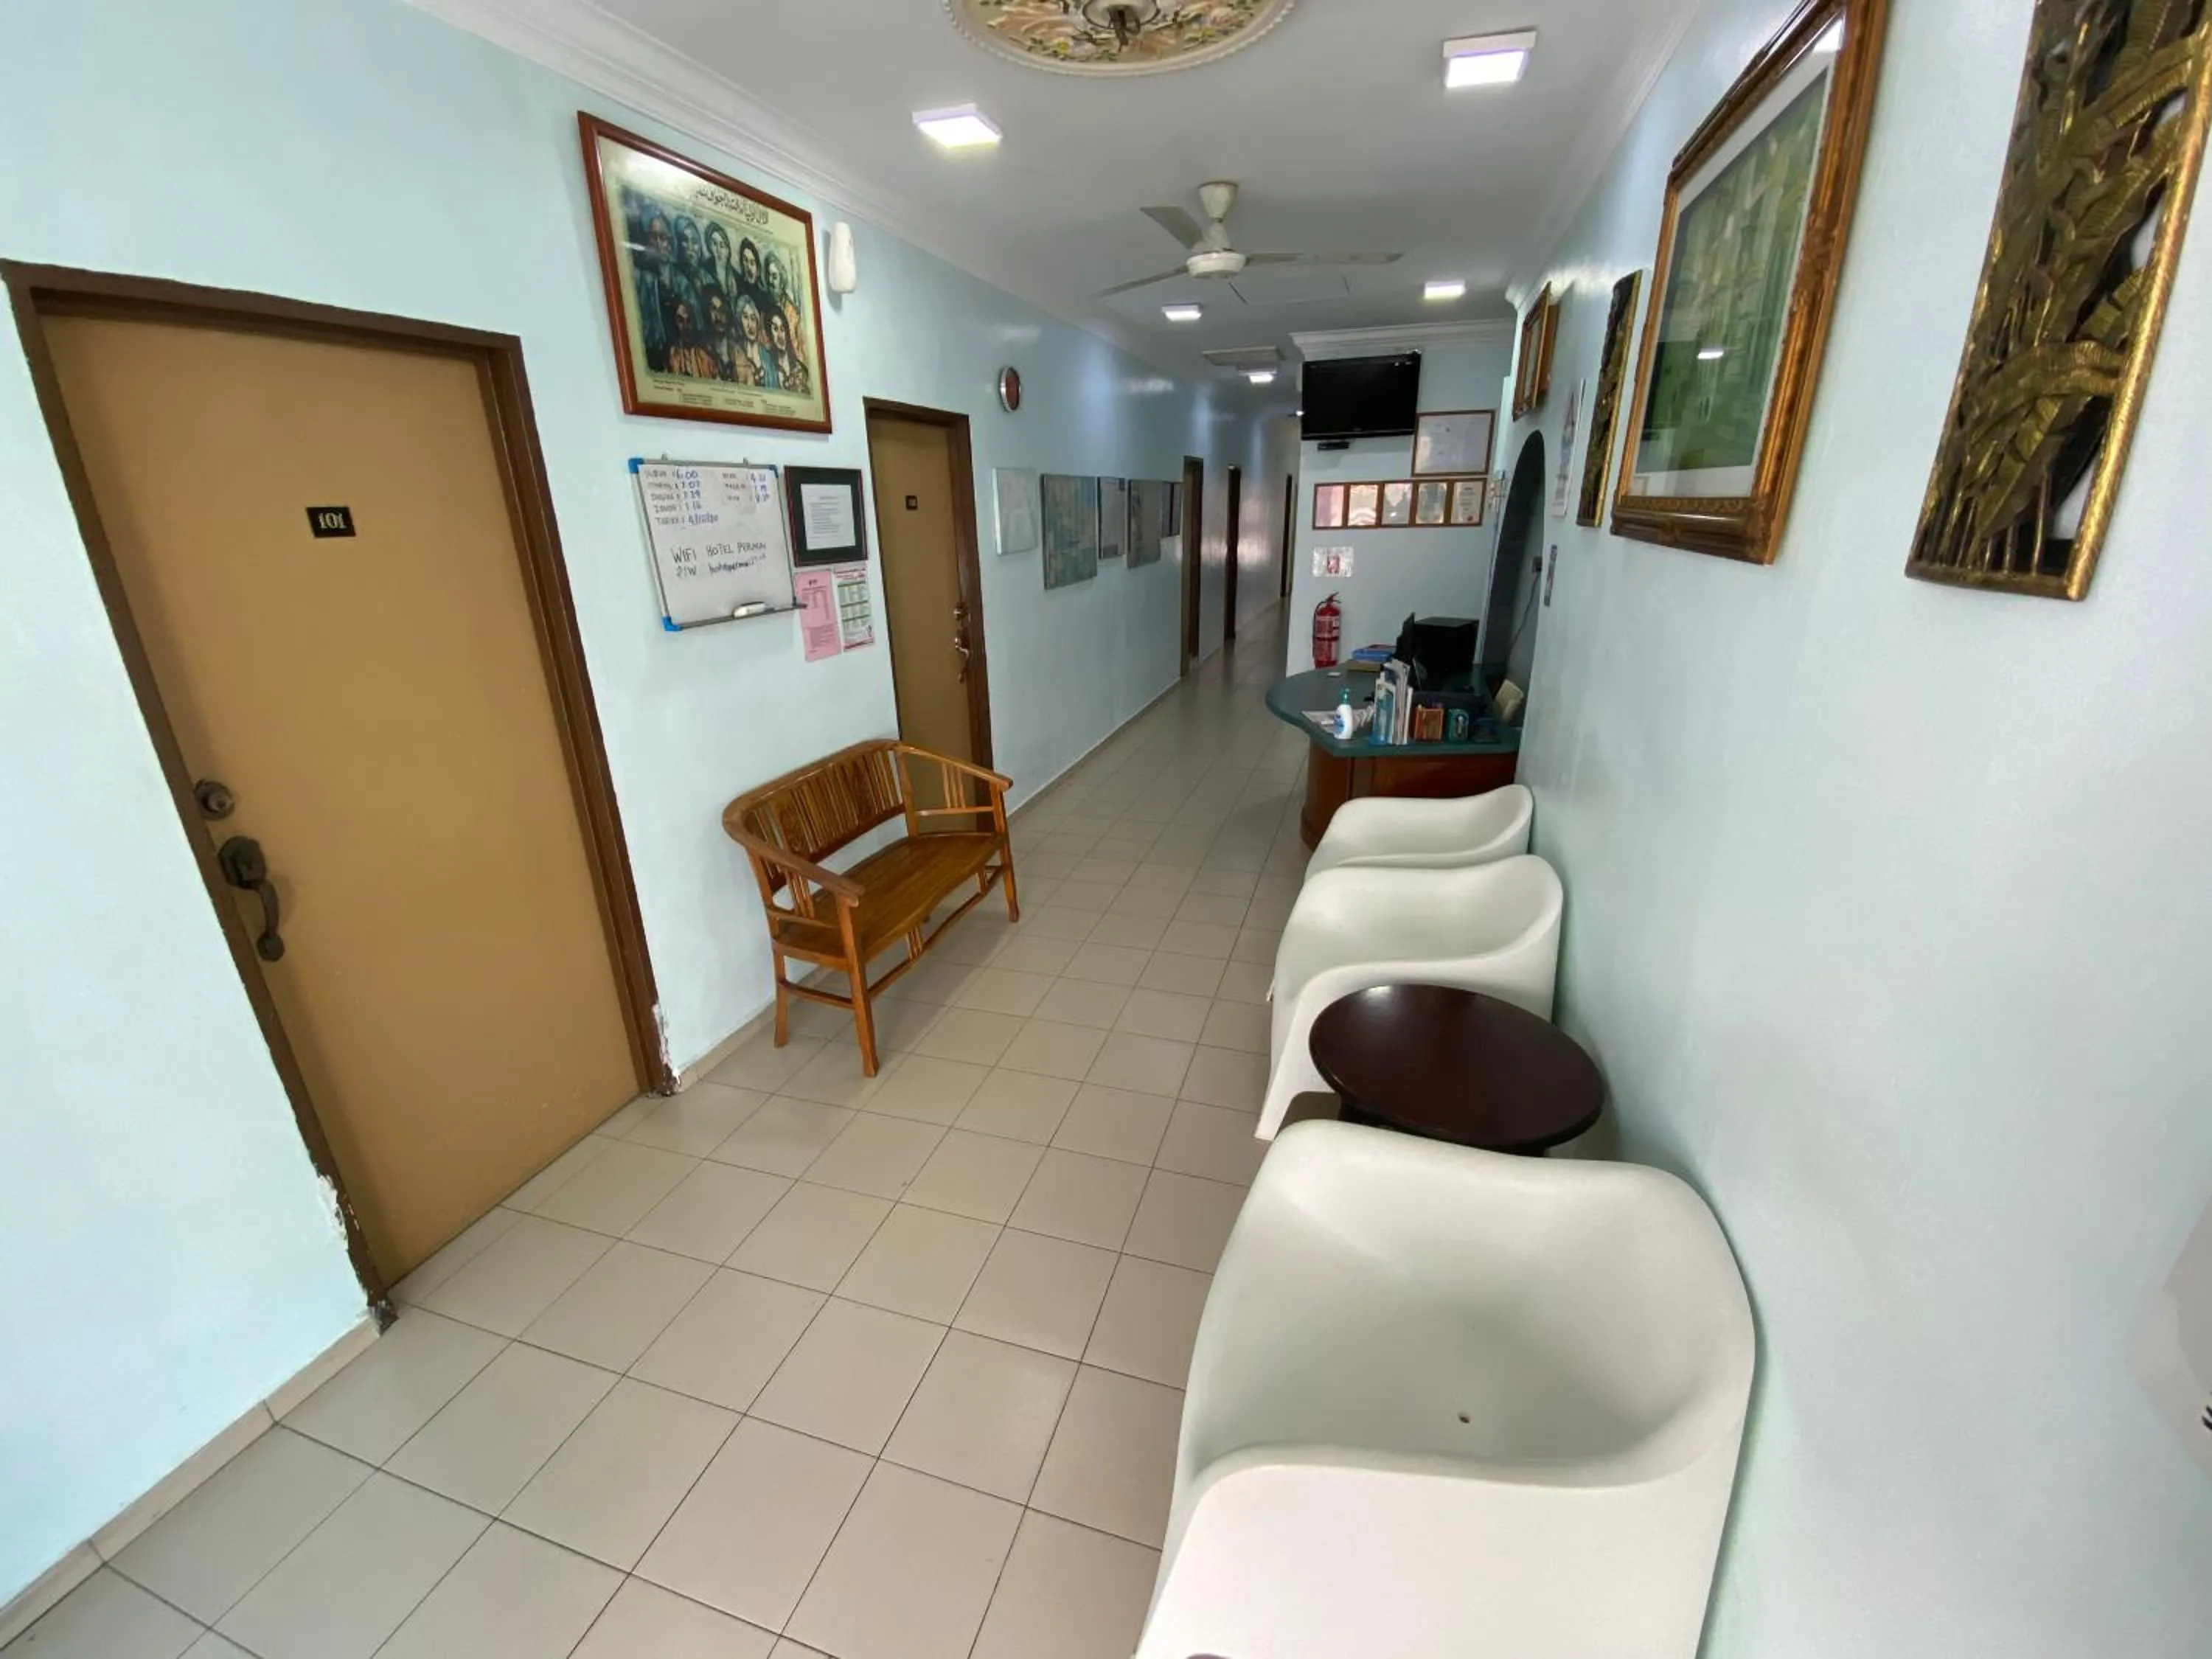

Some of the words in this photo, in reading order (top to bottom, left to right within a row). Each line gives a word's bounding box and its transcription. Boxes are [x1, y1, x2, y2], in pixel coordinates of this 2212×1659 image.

[318, 512, 347, 529] 101
[669, 545, 697, 563] WIFI
[706, 543, 734, 557] HOTEL
